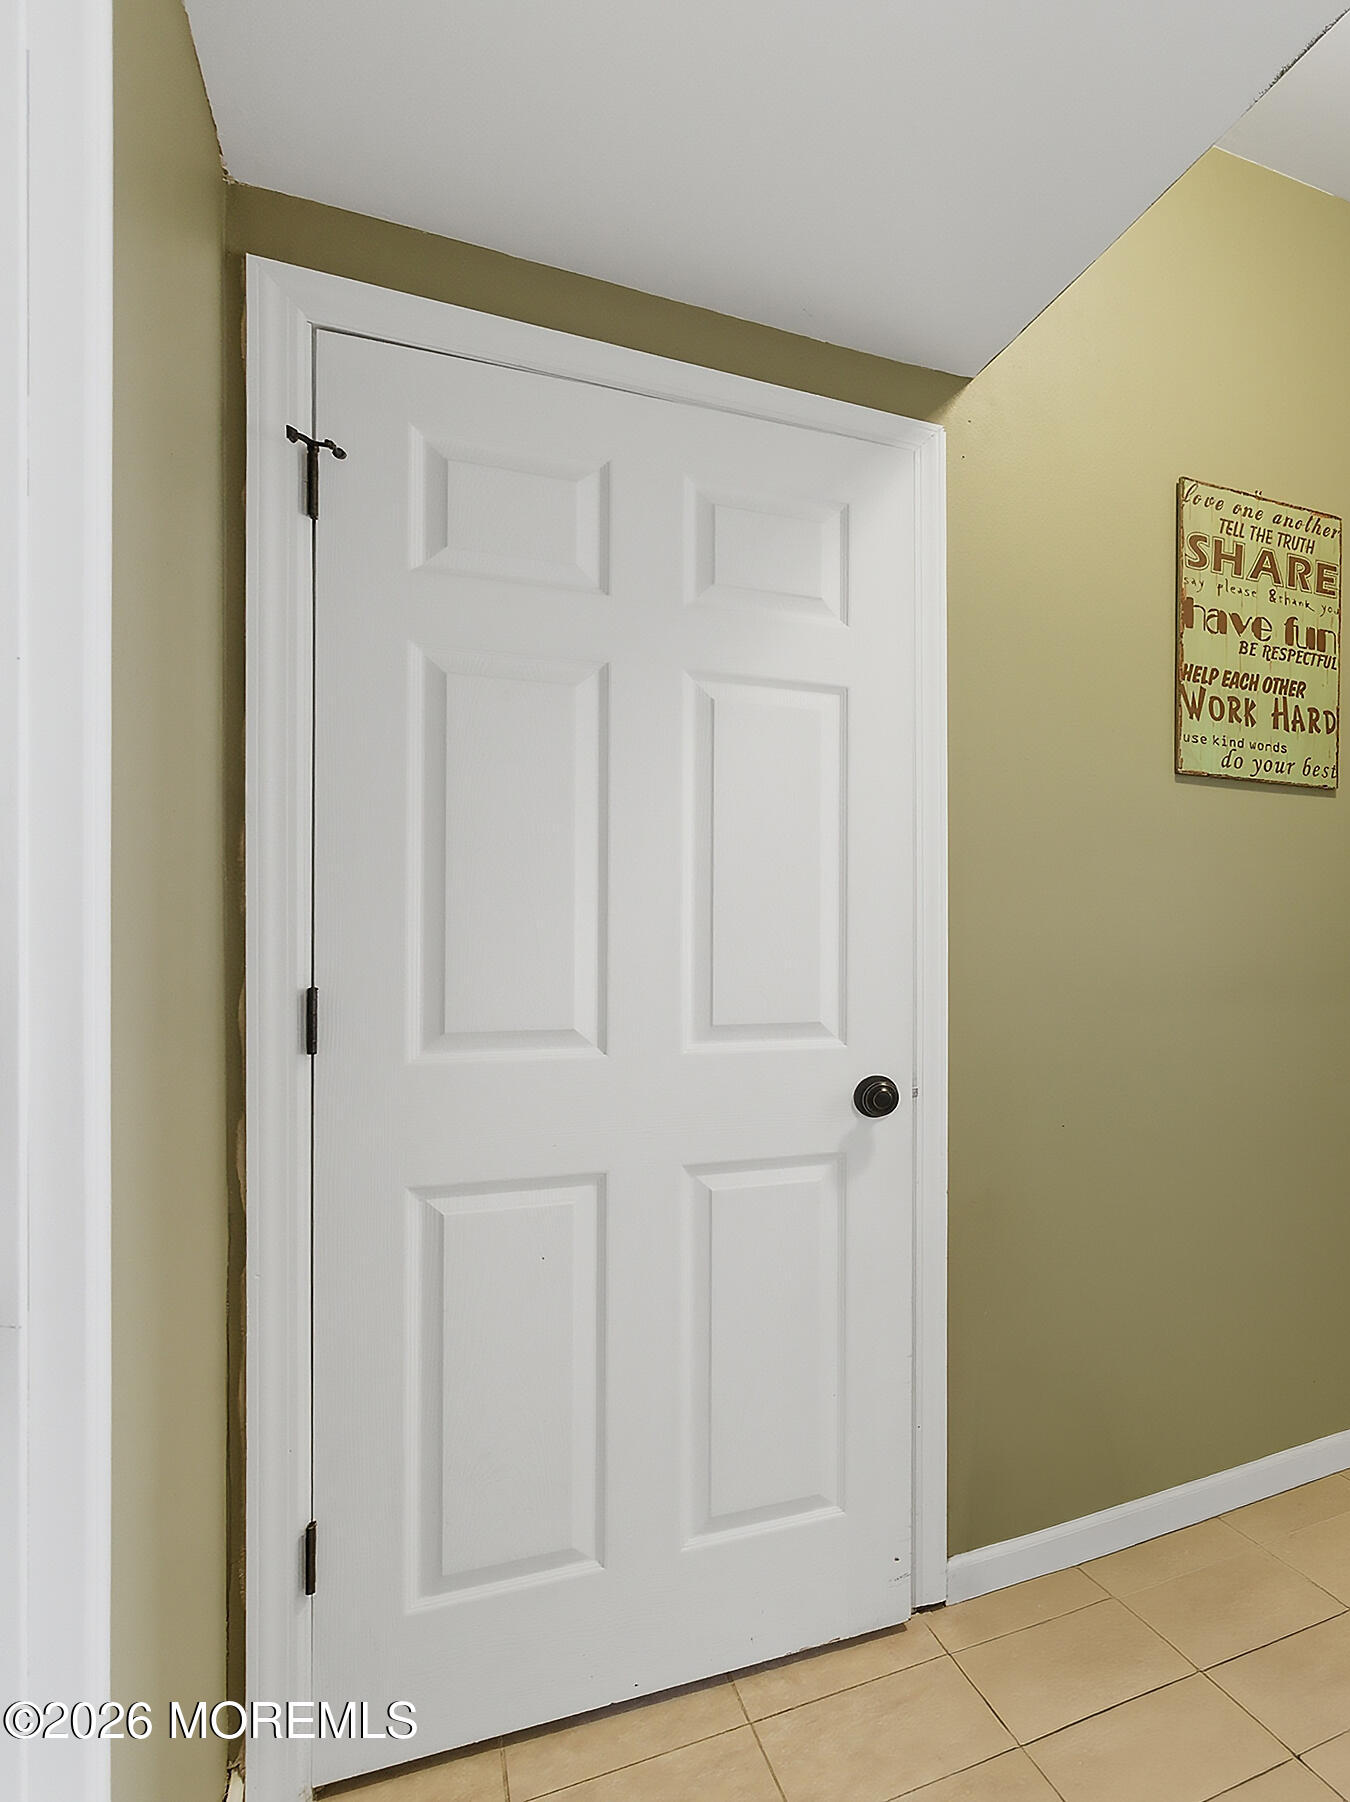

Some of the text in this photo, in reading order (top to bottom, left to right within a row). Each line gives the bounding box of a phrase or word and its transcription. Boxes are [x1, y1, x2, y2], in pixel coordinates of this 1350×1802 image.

[1219, 518, 1316, 555] TELL THE TRUTH
[1232, 503, 1264, 521] one
[1272, 512, 1341, 539] another
[1184, 532, 1338, 599] SHARE
[1183, 577, 1205, 592] say
[1217, 579, 1257, 598] please
[1183, 597, 1337, 654] have fun
[1239, 641, 1338, 670] BE RESPECTFUL
[1182, 663, 1307, 699] HELP EACH OTHER
[1180, 684, 1337, 735] WORK HARD
[1183, 734, 1288, 753] use kind words
[1221, 749, 1338, 779] do your best
